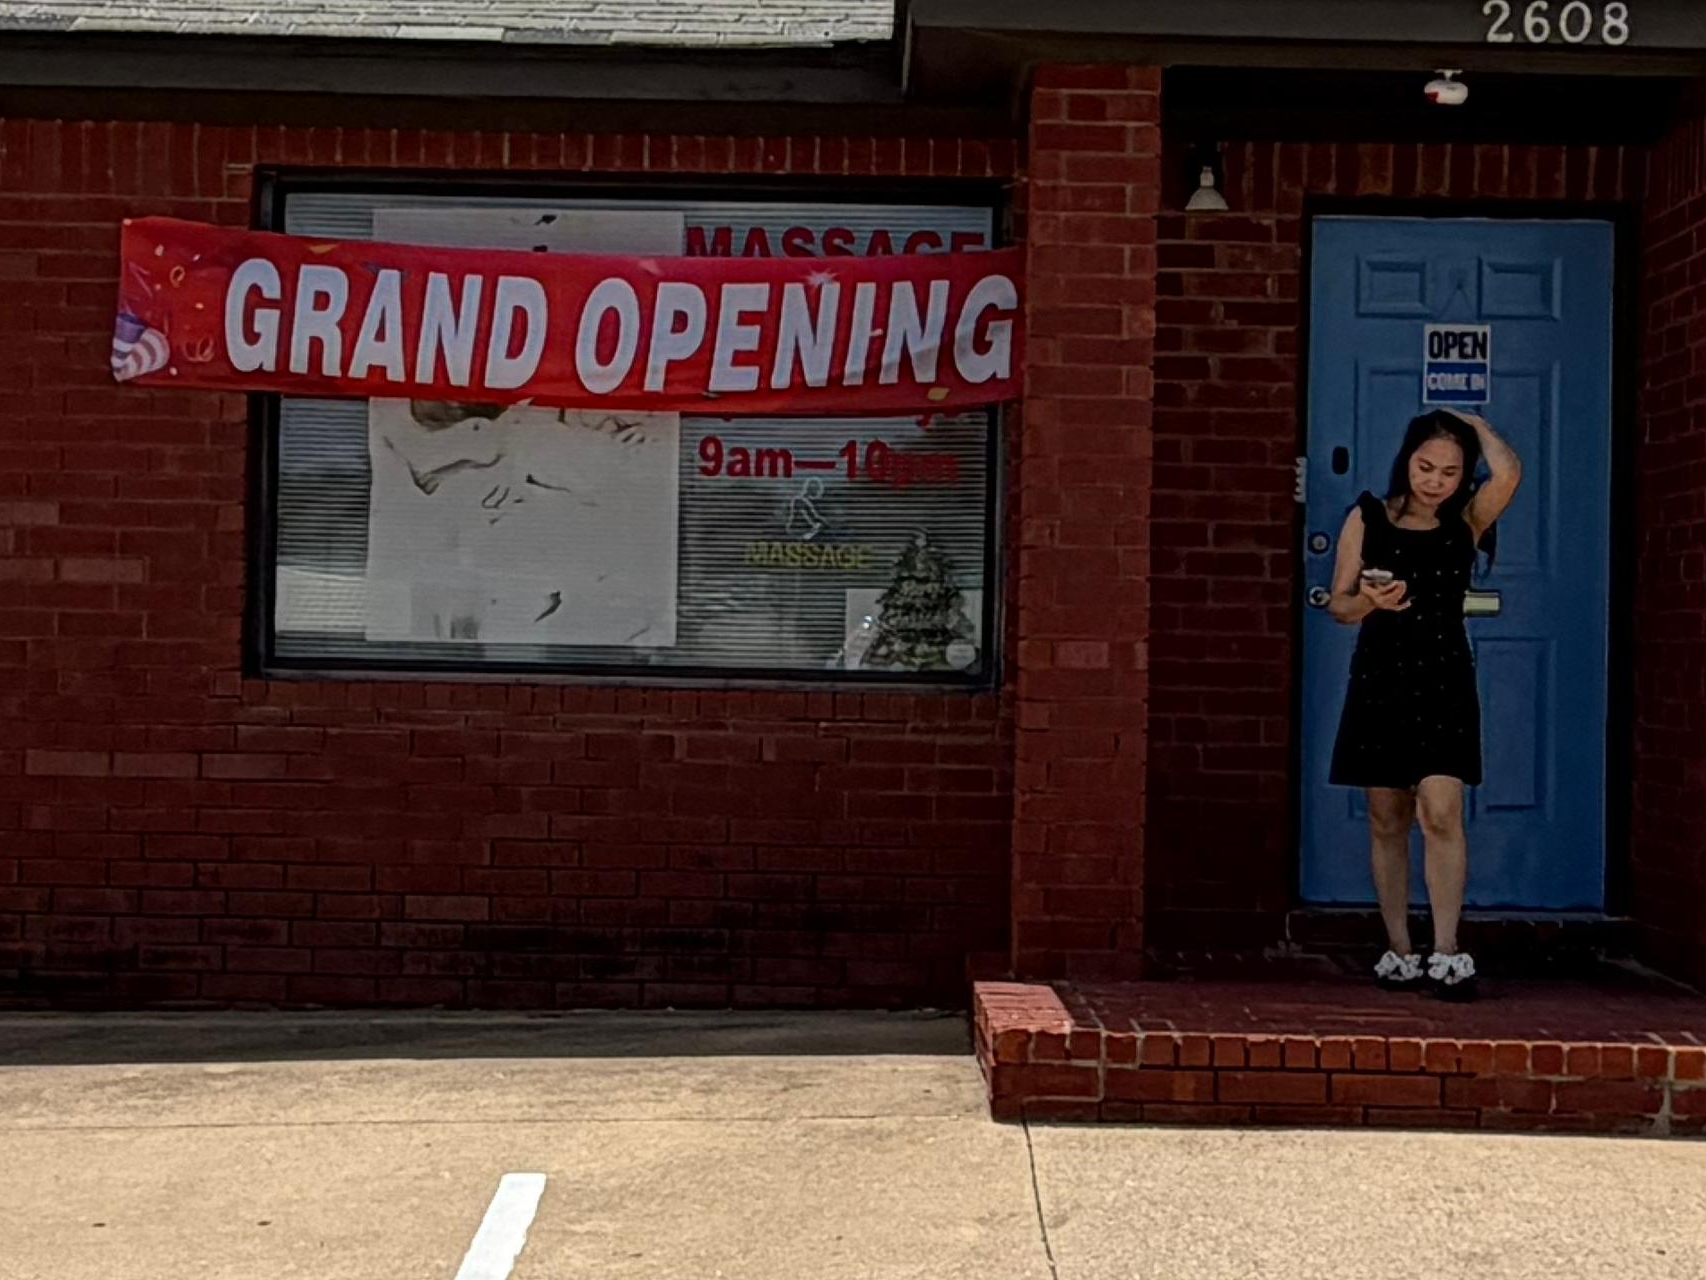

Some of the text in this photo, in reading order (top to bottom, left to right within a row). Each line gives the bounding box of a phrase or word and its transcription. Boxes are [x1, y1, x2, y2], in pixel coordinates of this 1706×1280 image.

[223, 258, 1019, 395] GRAND OPENING
[1428, 330, 1488, 360] OPEN
